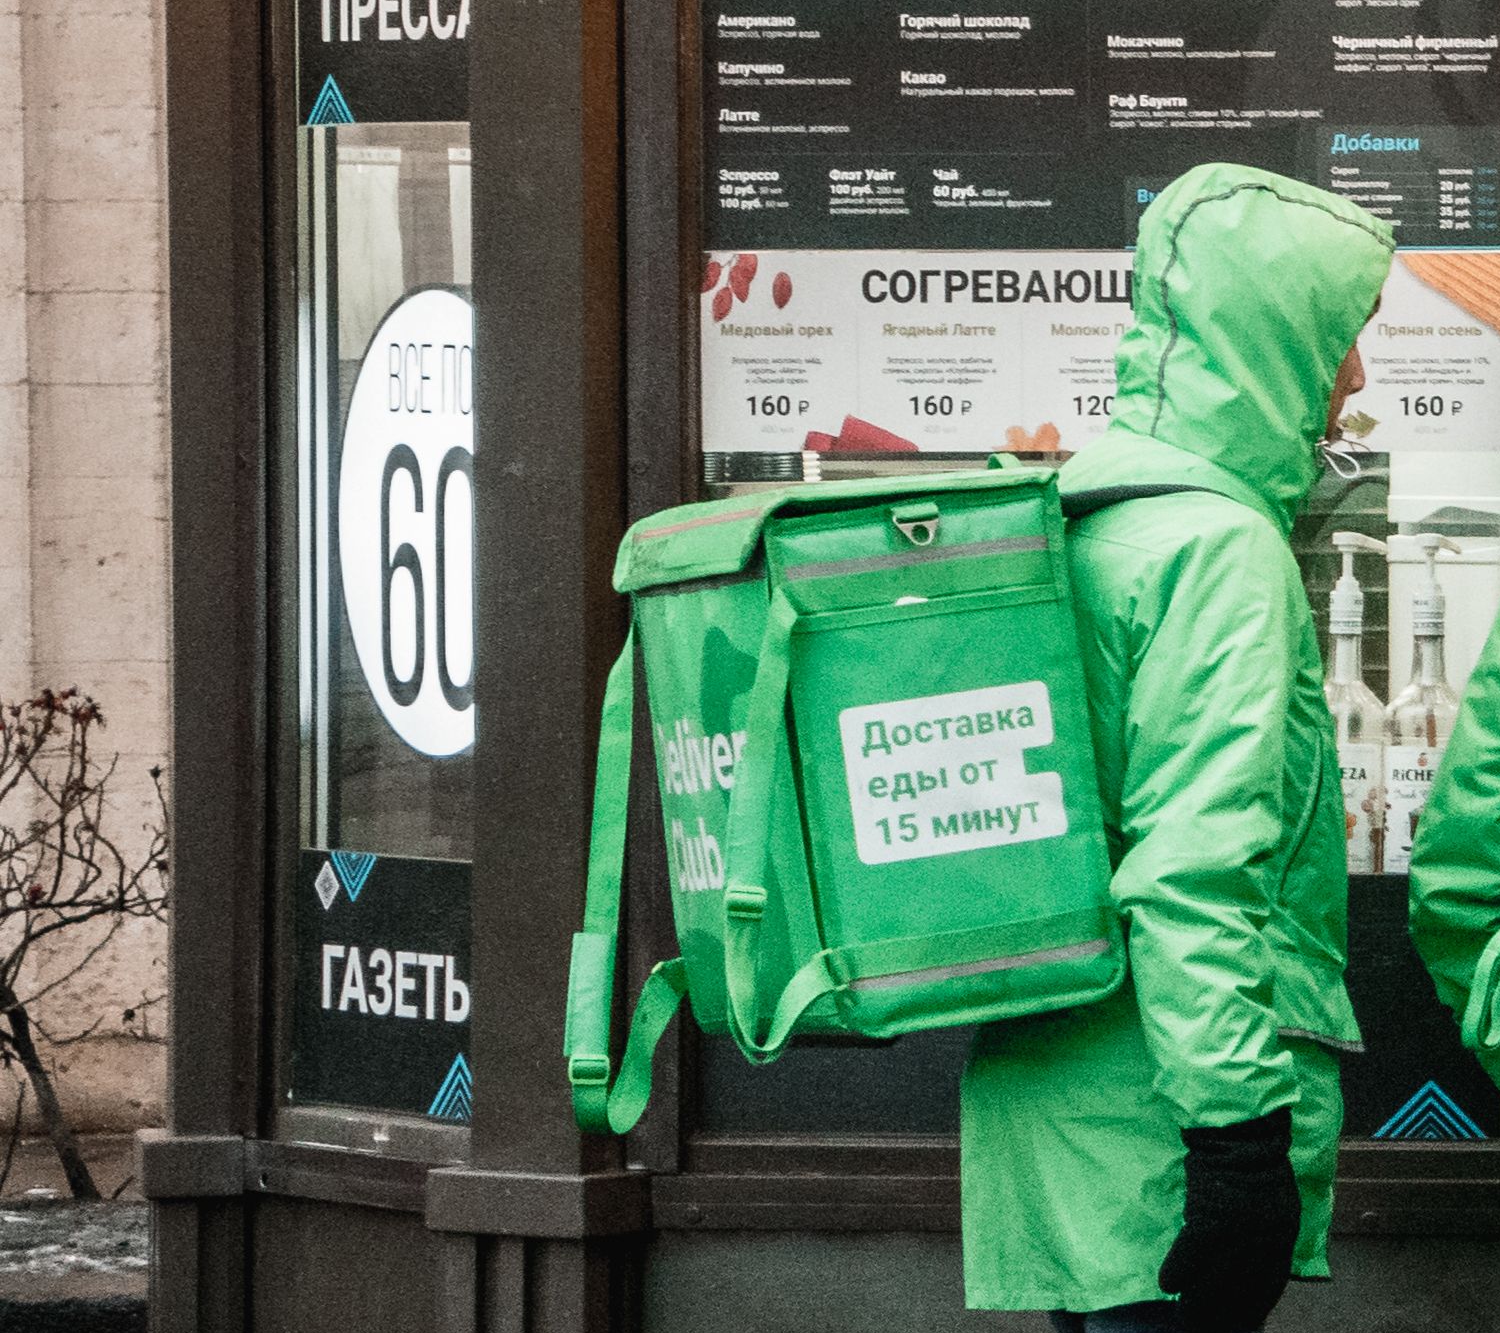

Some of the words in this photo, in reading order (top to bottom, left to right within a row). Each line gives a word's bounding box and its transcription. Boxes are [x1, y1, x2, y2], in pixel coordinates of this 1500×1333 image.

[717, 14, 796, 29] Американо
[899, 14, 961, 29] Горячий
[964, 16, 1031, 30] шоколад
[1107, 35, 1185, 48] Мокаччино
[1332, 35, 1413, 50] Черничный
[1415, 35, 1499, 51] фирменный
[717, 61, 785, 77] Капучино
[900, 71, 947, 84] Какао
[1108, 94, 1138, 109] Раф
[1139, 94, 1188, 109] Баунти
[718, 109, 760, 122] Латте
[1331, 133, 1420, 155] Добавки
[718, 169, 780, 183] Эспрессо
[829, 169, 863, 182] Флэт
[865, 168, 897, 181] Уайт
[932, 168, 959, 181] Чай
[718, 185, 733, 195] 60
[734, 185, 757, 197] руб.
[829, 184, 850, 195] 100
[851, 184, 874, 197] руб.
[932, 184, 950, 197] 60
[951, 183, 979, 199] руб.
[719, 199, 740, 209] 100
[861, 269, 1134, 311] СОГРЕВАЮЩ
[720, 322, 794, 338] Медовый
[797, 326, 833, 339] орех
[882, 323, 948, 338] Ягодный
[952, 323, 997, 337] Латте
[1050, 323, 1111, 337] Молоко
[1377, 323, 1434, 339] Пряная
[1438, 325, 1483, 337] осень
[388, 343, 432, 414] ВСЕ
[441, 344, 474, 415] ПО
[746, 395, 791, 416] 160
[909, 395, 954, 416] 160
[1073, 395, 1115, 416] 120
[1399, 395, 1444, 416] 160
[380, 442, 475, 713] 60
[861, 702, 1036, 757] Доставка
[658, 714, 747, 796] eliver
[868, 764, 949, 802] еды
[959, 756, 999, 786] от
[1392, 768, 1435, 782] RiCHE
[874, 816, 921, 847] 15
[931, 799, 1040, 842] минут
